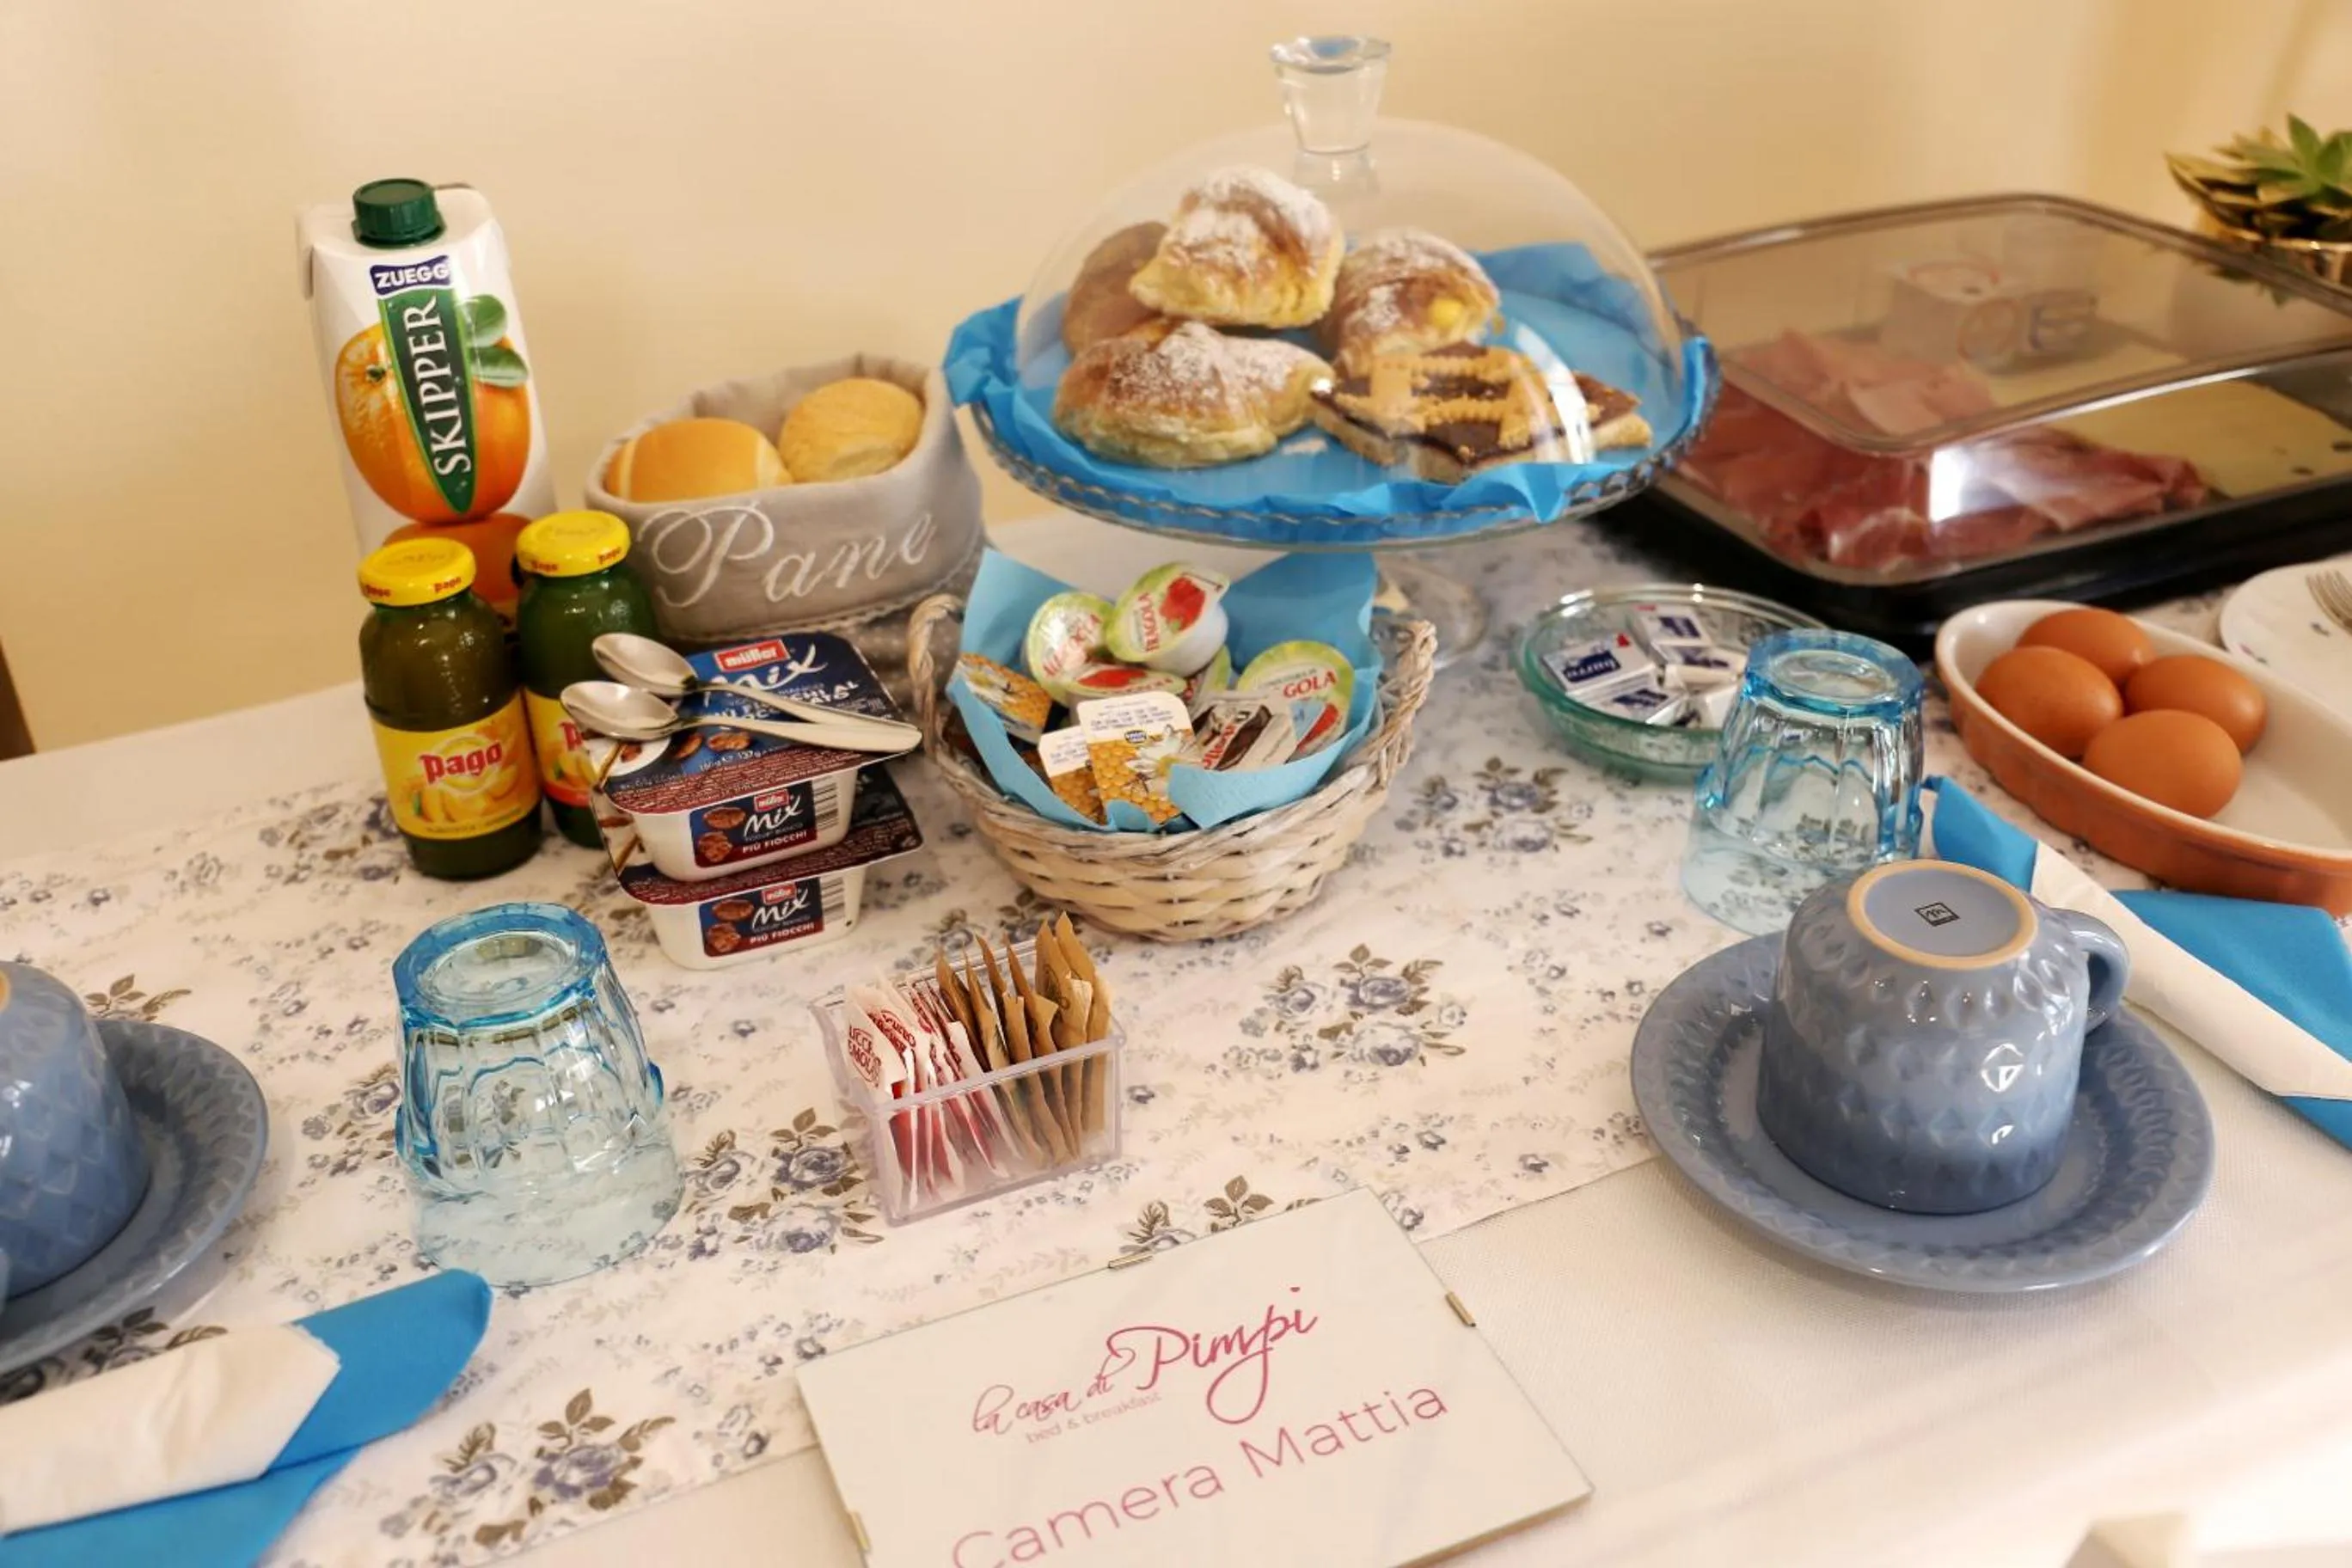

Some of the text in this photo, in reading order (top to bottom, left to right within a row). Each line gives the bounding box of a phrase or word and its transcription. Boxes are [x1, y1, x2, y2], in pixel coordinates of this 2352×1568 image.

[375, 262, 450, 289] ZUEGG
[402, 295, 472, 476] SKIPPER
[637, 500, 937, 609] Pane
[1283, 670, 1338, 697] GOLA
[764, 830, 807, 848] FIOCCHI
[772, 922, 815, 940] FIOCCHI
[972, 1286, 1319, 1435] la casa di Pimpi
[1025, 1389, 1163, 1444] bed & breakfast
[952, 1387, 1449, 1568] Camera Mattia
